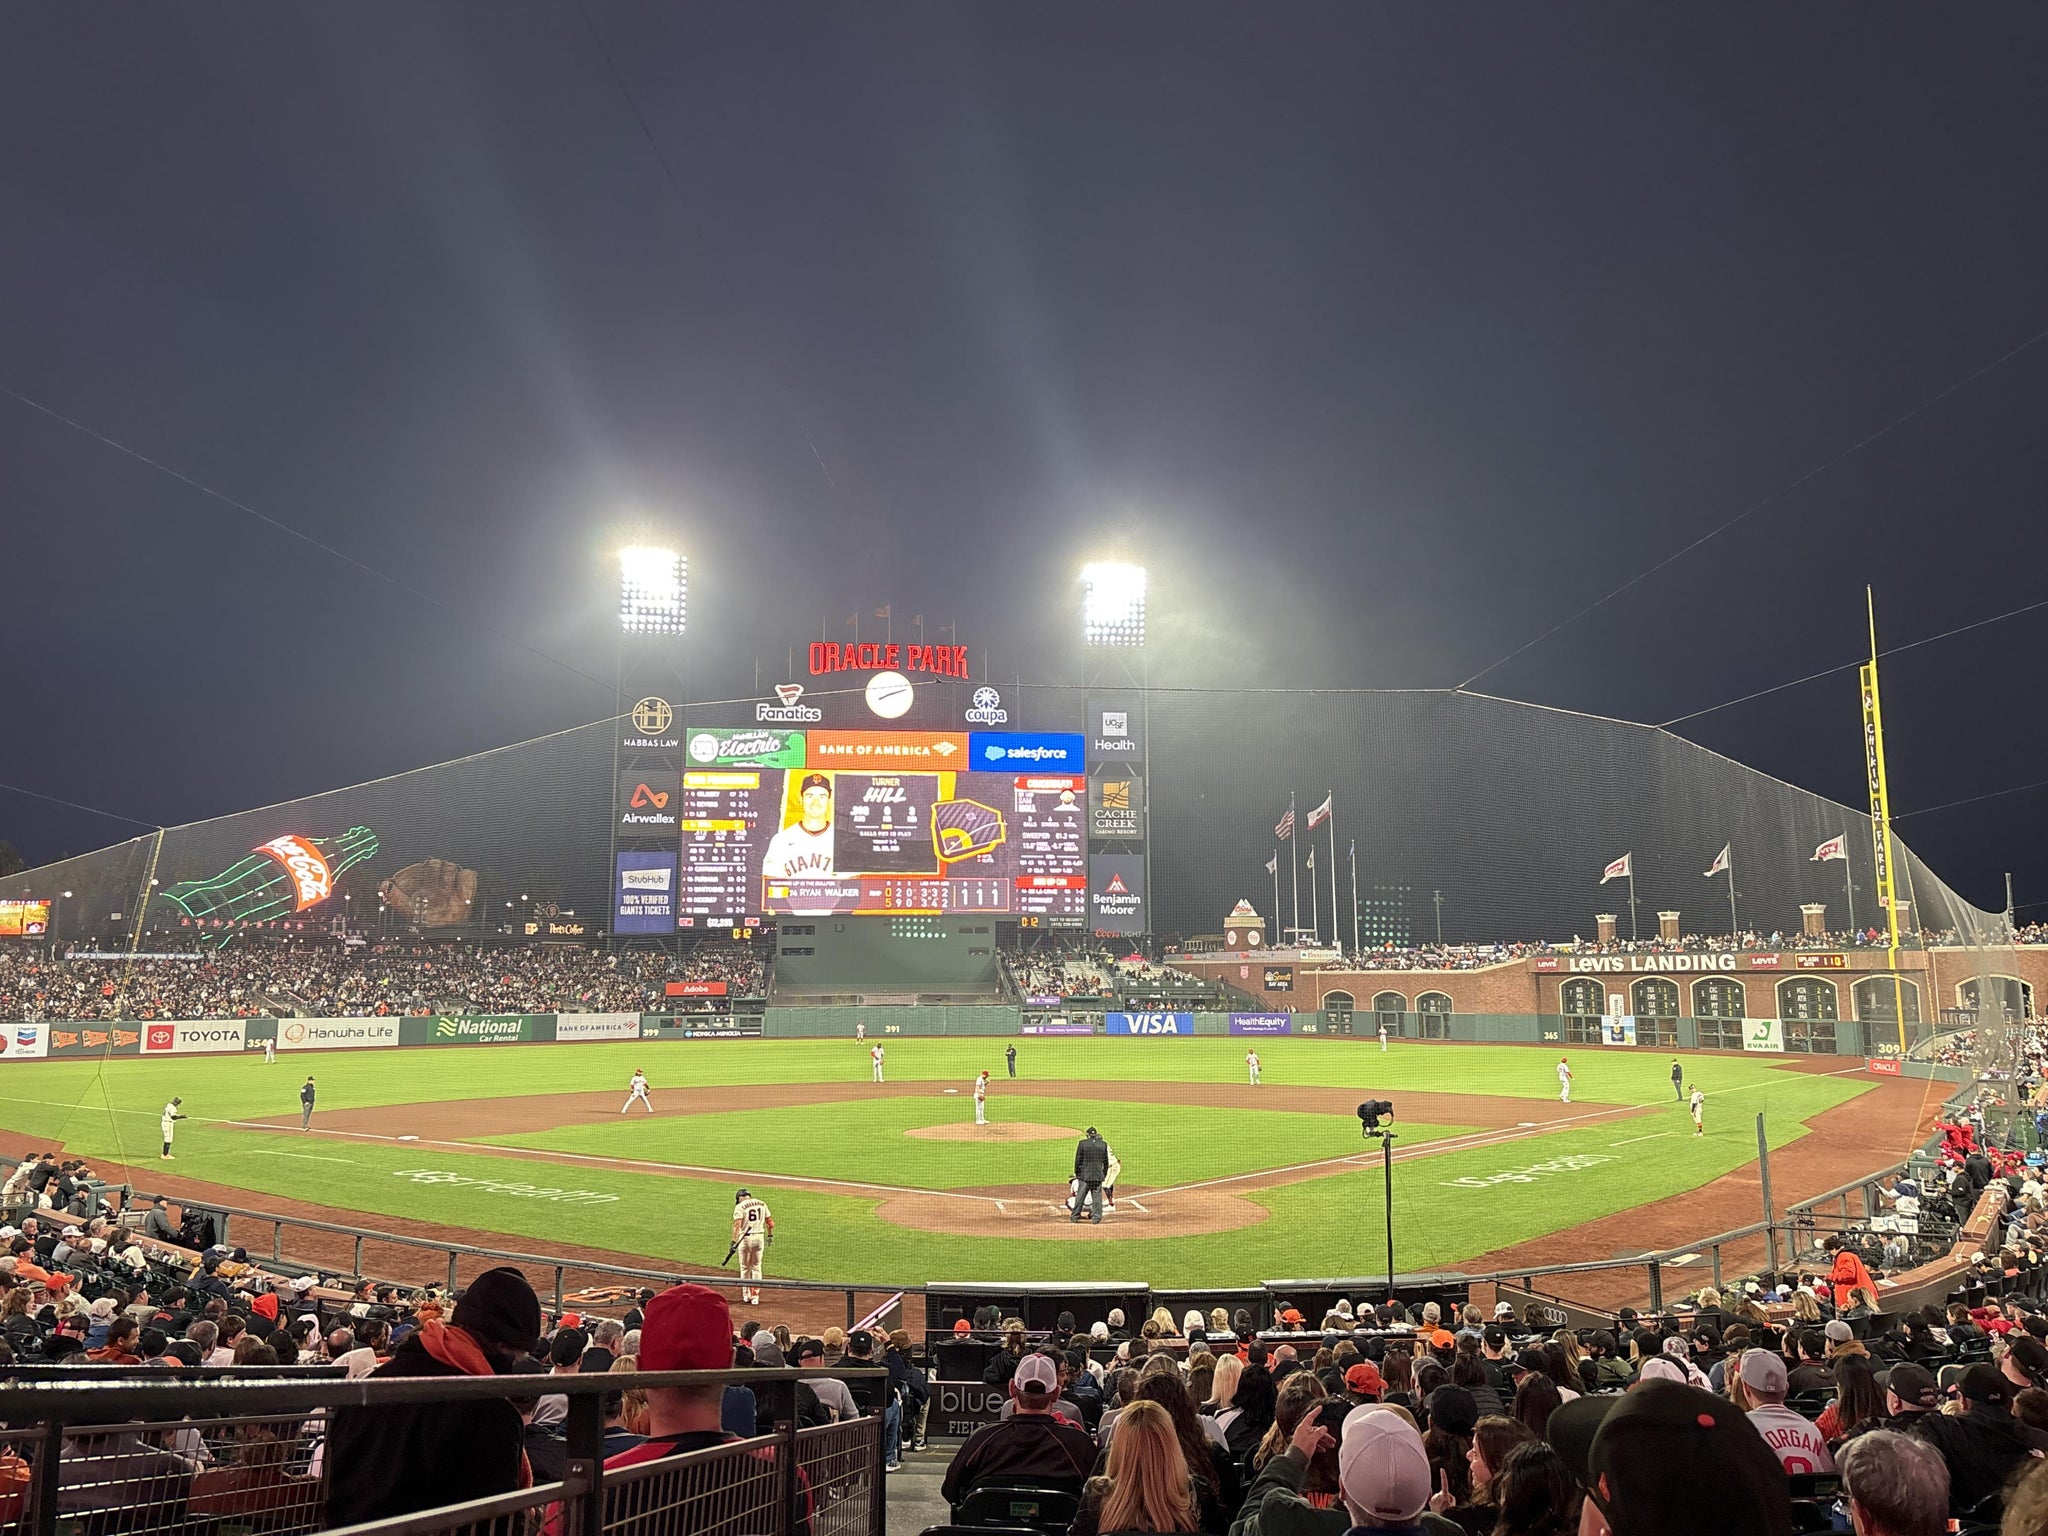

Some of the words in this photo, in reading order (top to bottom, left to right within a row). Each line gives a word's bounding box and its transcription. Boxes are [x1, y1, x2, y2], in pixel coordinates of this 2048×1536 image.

[809, 643, 900, 676] ORACLE
[907, 644, 969, 680] PARK
[758, 705, 820, 720] Fanatics
[967, 711, 1006, 724] coupa
[624, 739, 659, 748] HABBAS
[660, 740, 679, 748] LAW
[719, 737, 781, 756] Electric
[1095, 739, 1135, 752] Health
[819, 745, 854, 754] BANK
[856, 745, 871, 754] OF
[873, 745, 931, 756] AMERICA
[1007, 748, 1067, 761] salesforce
[1866, 723, 1880, 790] CHIKIN
[872, 777, 900, 787] TURNER
[863, 787, 907, 803] HILL
[1094, 809, 1138, 819] CACHE
[1874, 801, 1882, 820] IZ
[622, 813, 676, 825] Airwallex
[1095, 819, 1136, 828] CREEK
[628, 875, 664, 884] StubHub
[799, 888, 821, 897] RYAN
[824, 888, 859, 898] WALKER
[885, 888, 892, 898] 0
[896, 888, 902, 898] 2
[906, 888, 912, 898] 0
[921, 888, 927, 898] 3
[941, 888, 948, 898] 2
[622, 895, 642, 906] 100%
[642, 893, 669, 905] VERIFIED
[906, 898, 912, 907] 0
[921, 898, 927, 907] 3
[941, 898, 948, 907] 2
[1093, 893, 1141, 906] Benjamin
[620, 906, 645, 916] GIANTS
[645, 905, 670, 916] TICKETS
[1100, 904, 1135, 915] Moore
[549, 924, 565, 935] Peet's
[565, 925, 584, 936] Coffee
[1095, 928, 1120, 938] Coors
[1120, 930, 1141, 938] LIGHT
[1630, 953, 1737, 972] LANDING
[683, 985, 709, 993] Adobe
[457, 1018, 523, 1035] National
[590, 1024, 622, 1032] AMERICA
[1122, 1015, 1178, 1034] VISA
[1234, 1017, 1287, 1028] HealthEquity
[181, 1030, 240, 1043] TOYOTA
[308, 1028, 365, 1040] Hanwha
[368, 1026, 393, 1038] Life
[493, 1034, 519, 1042] Rental
[642, 1029, 659, 1037] 399
[1544, 1032, 1559, 1040] 365
[246, 1038, 268, 1048] 354
[1879, 1043, 1900, 1054] 309
[1872, 1063, 1897, 1072] ORACLE
[748, 1208, 761, 1222] 61
[940, 1385, 1004, 1414] blue
[1765, 1428, 1823, 1457] ORGAN
